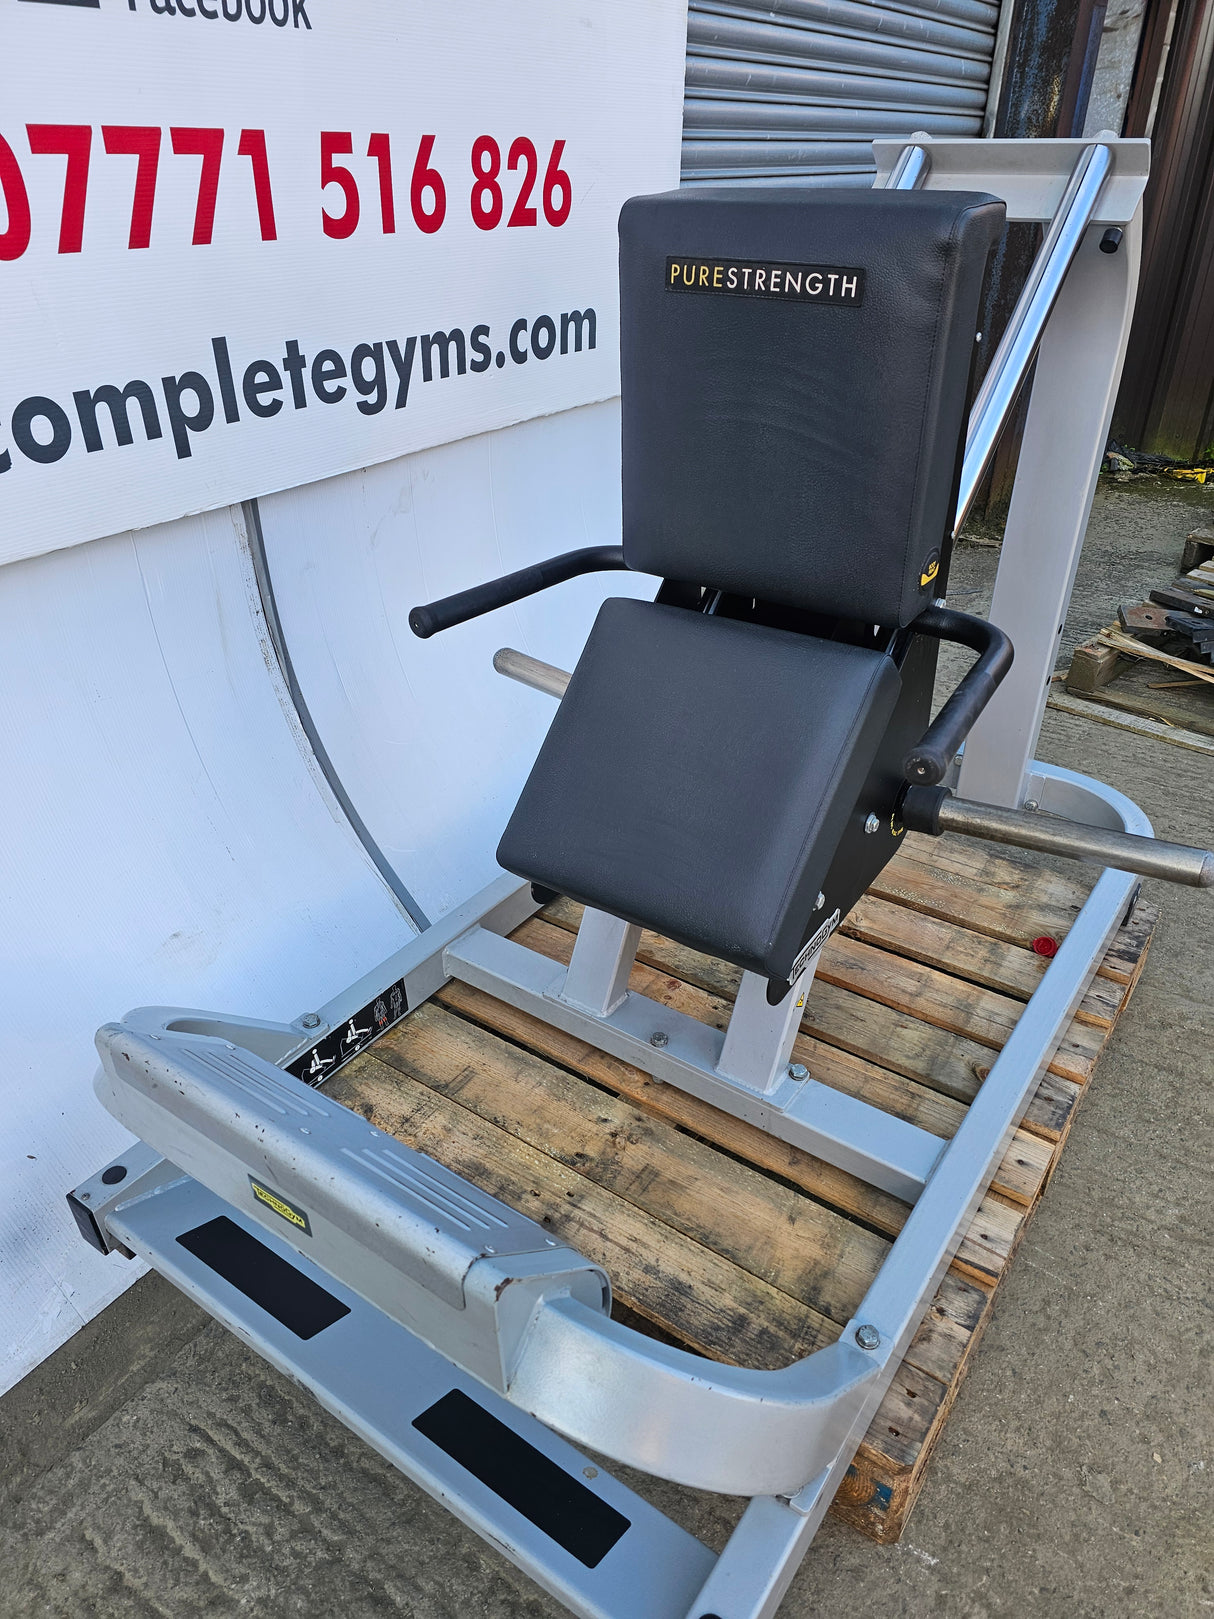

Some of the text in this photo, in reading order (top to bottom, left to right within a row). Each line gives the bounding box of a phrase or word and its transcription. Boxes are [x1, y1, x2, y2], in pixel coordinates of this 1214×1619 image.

[321, 132, 445, 239] 516
[471, 136, 571, 230] 826
[670, 263, 858, 298] PURESTRENGTH
[0, 307, 597, 474] ompletegyms.com
